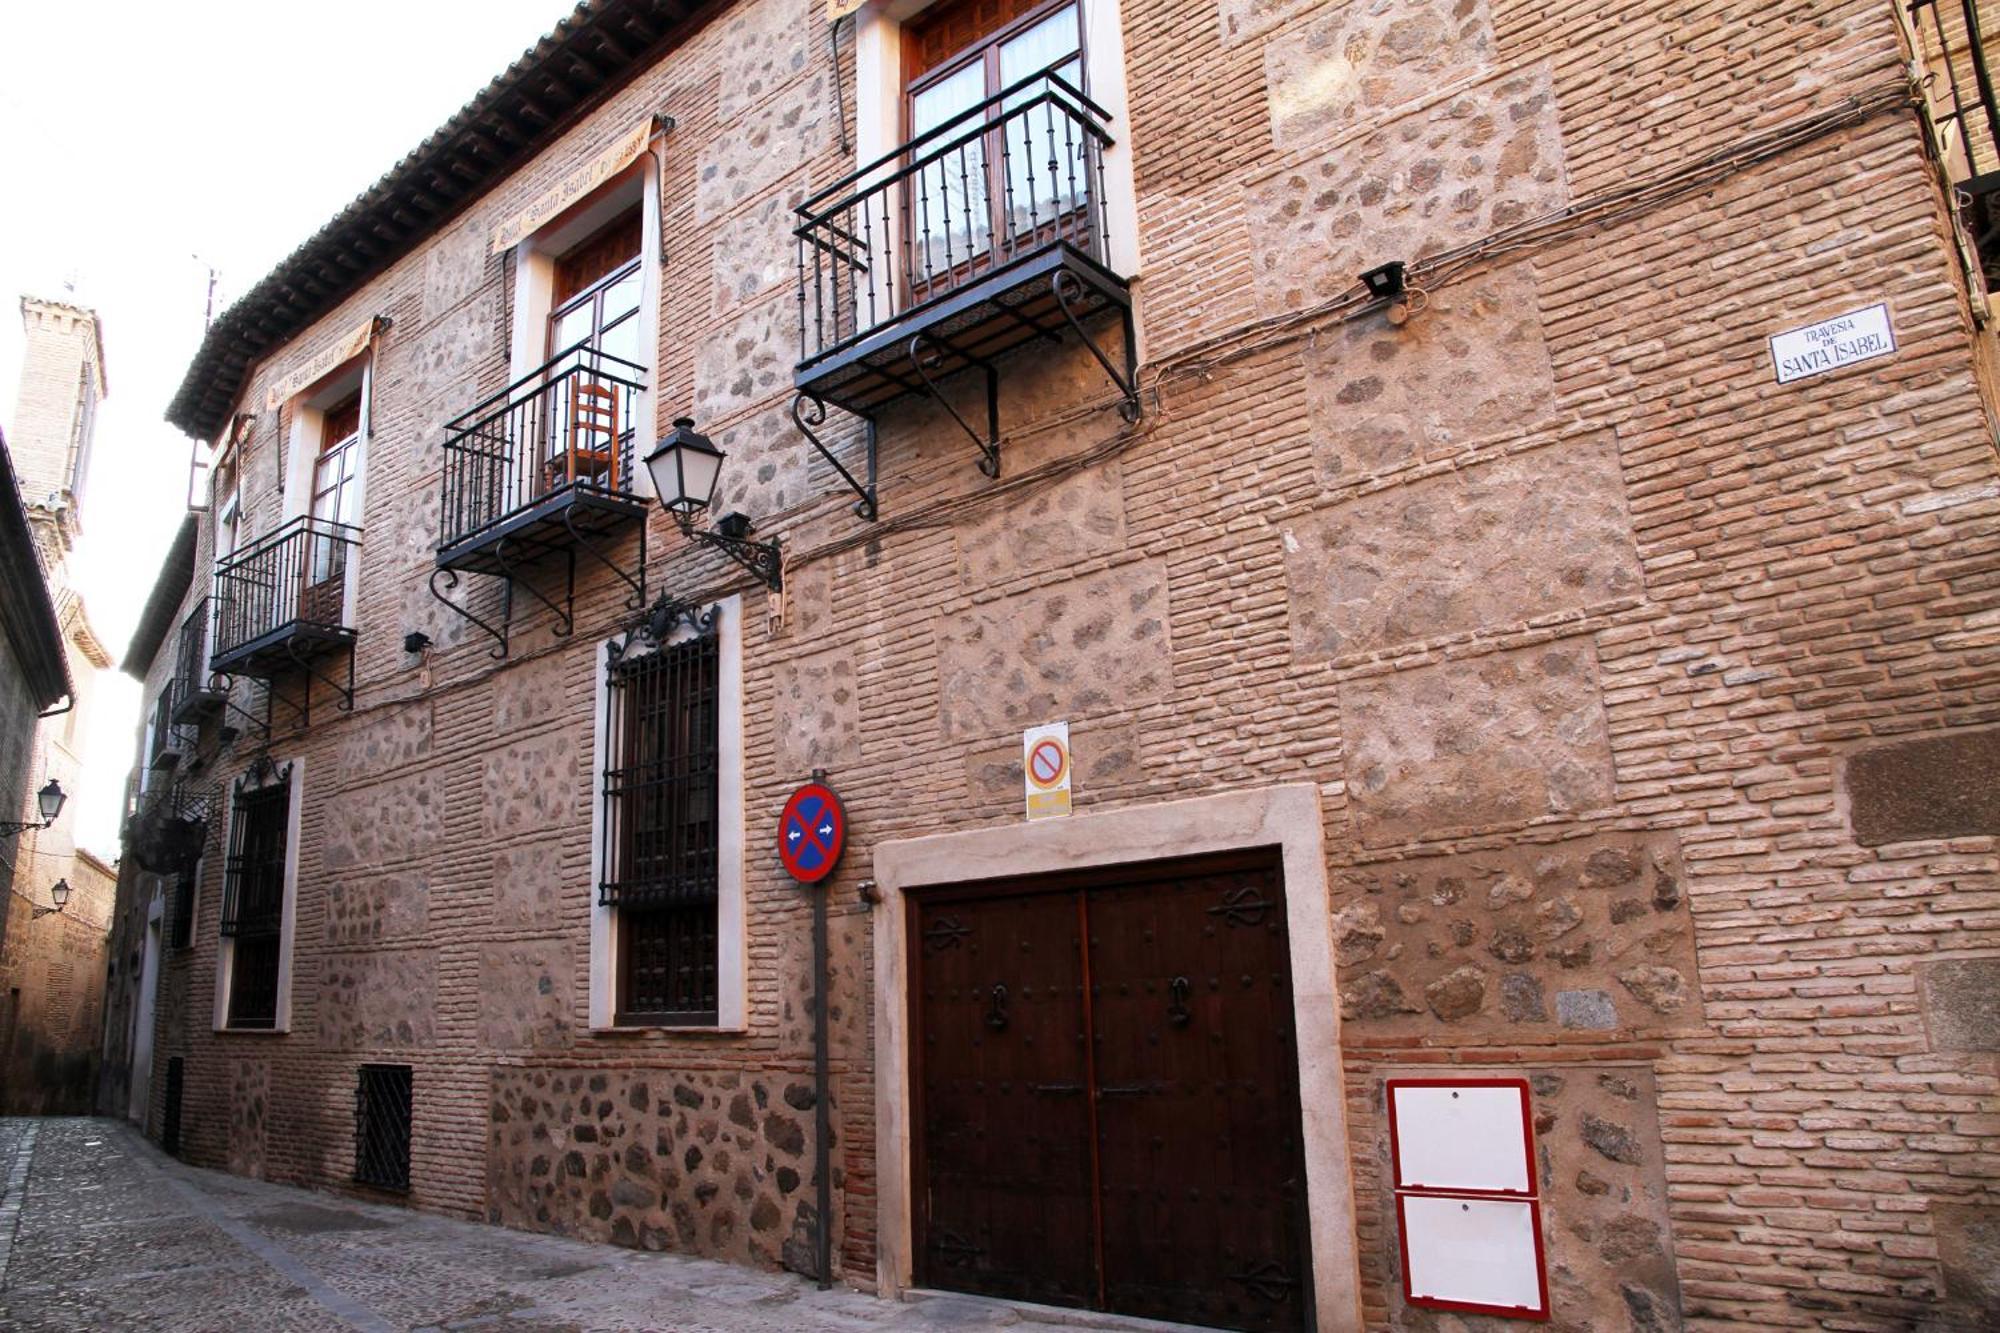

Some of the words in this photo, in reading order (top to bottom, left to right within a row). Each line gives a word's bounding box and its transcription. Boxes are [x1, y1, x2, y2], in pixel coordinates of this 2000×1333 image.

[1805, 319, 1855, 342] TRAVESIA
[1822, 338, 1837, 347] DE
[1783, 349, 1831, 376] SANTA
[1835, 333, 1887, 361] ISABEL
